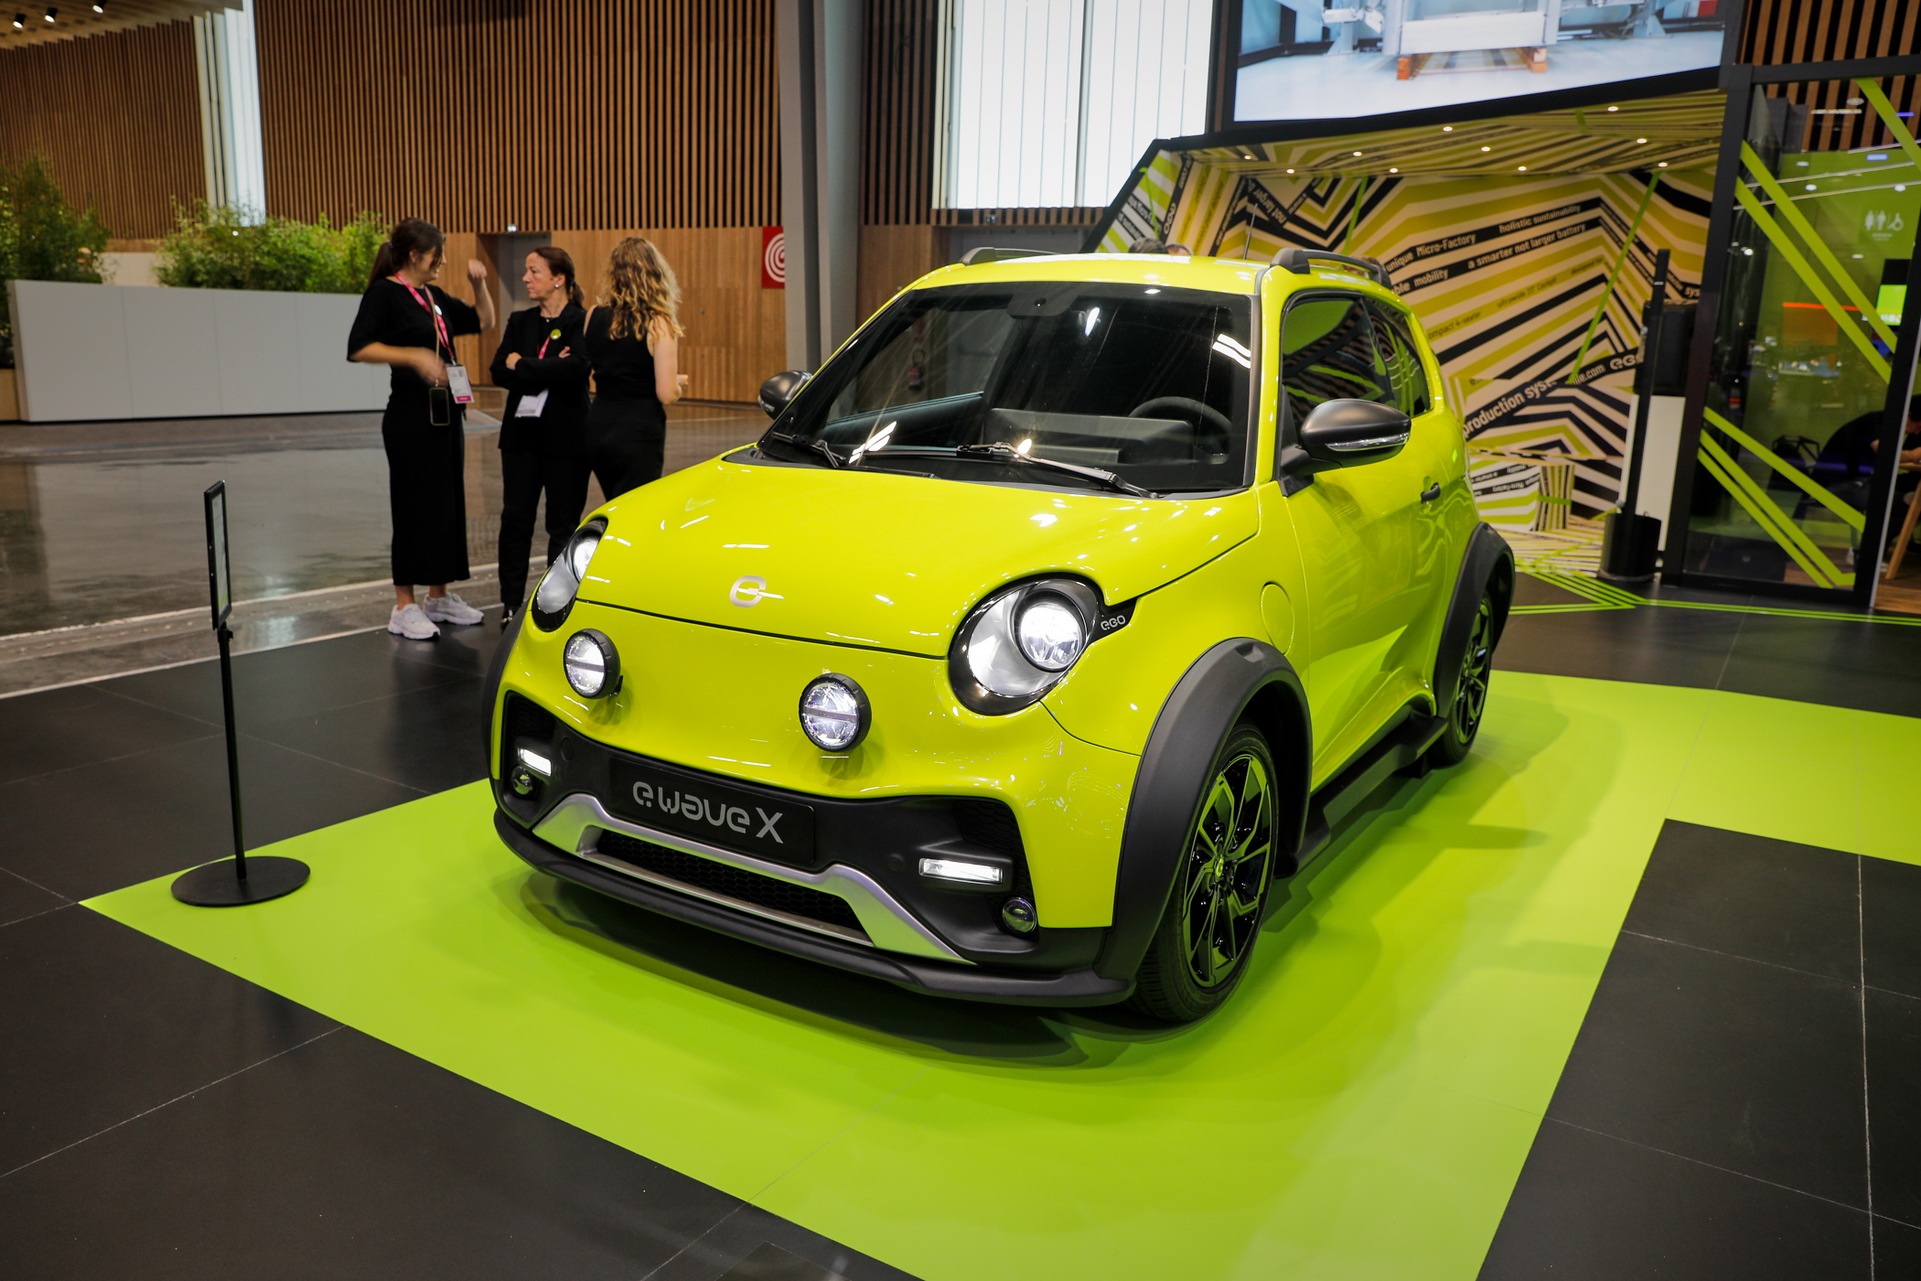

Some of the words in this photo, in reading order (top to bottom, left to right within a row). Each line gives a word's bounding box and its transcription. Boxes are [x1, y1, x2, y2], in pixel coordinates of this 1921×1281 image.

[1385, 252, 1414, 273] unique
[1416, 233, 1477, 257] Micro-Factory
[1499, 218, 1532, 234] holistic
[1533, 205, 1581, 224] sustainability
[1414, 268, 1449, 288] mobility
[1467, 260, 1476, 270] a
[1476, 246, 1514, 267] smarter
[1515, 240, 1530, 254] not
[1530, 232, 1556, 249] larger
[1557, 223, 1586, 240] battery
[1462, 391, 1525, 439] production
[755, 807, 784, 845] X
